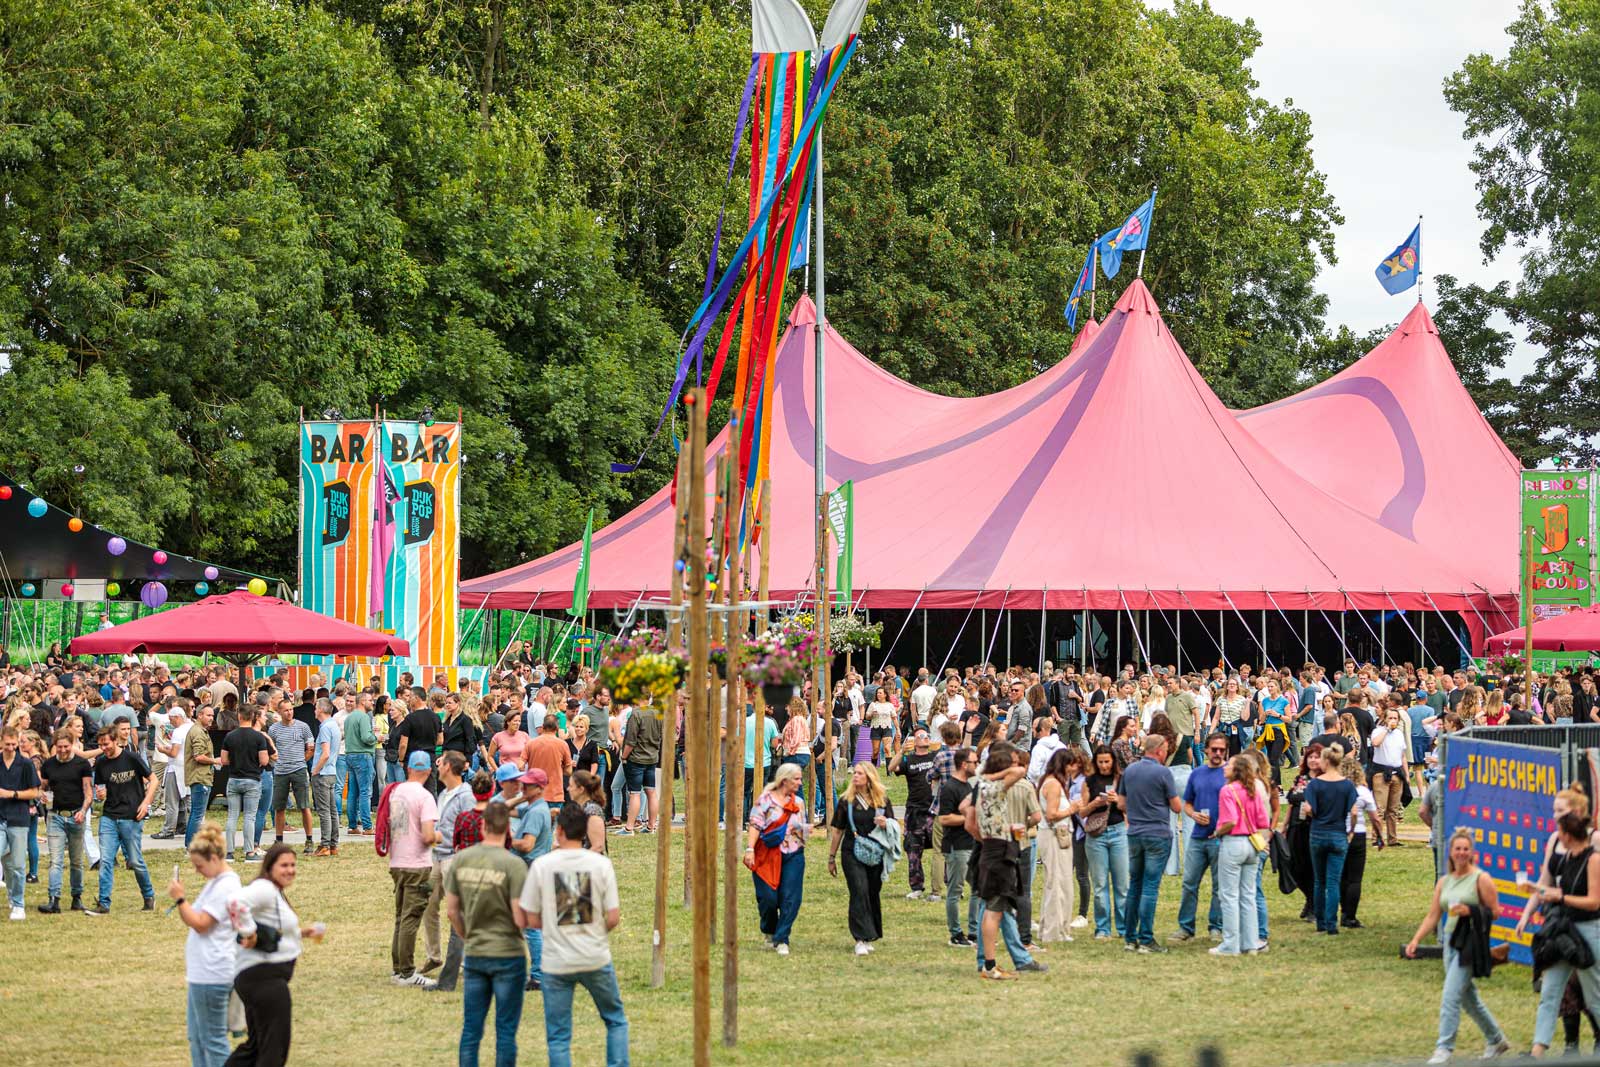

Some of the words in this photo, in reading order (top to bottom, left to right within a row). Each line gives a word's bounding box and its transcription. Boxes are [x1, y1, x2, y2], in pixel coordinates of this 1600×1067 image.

[311, 434, 365, 463] BAR
[391, 433, 450, 463] BAR
[330, 503, 349, 519] POP
[411, 502, 432, 519] POP
[1531, 560, 1575, 575] PARTY
[1468, 754, 1557, 796] TIJDSCHEMA
